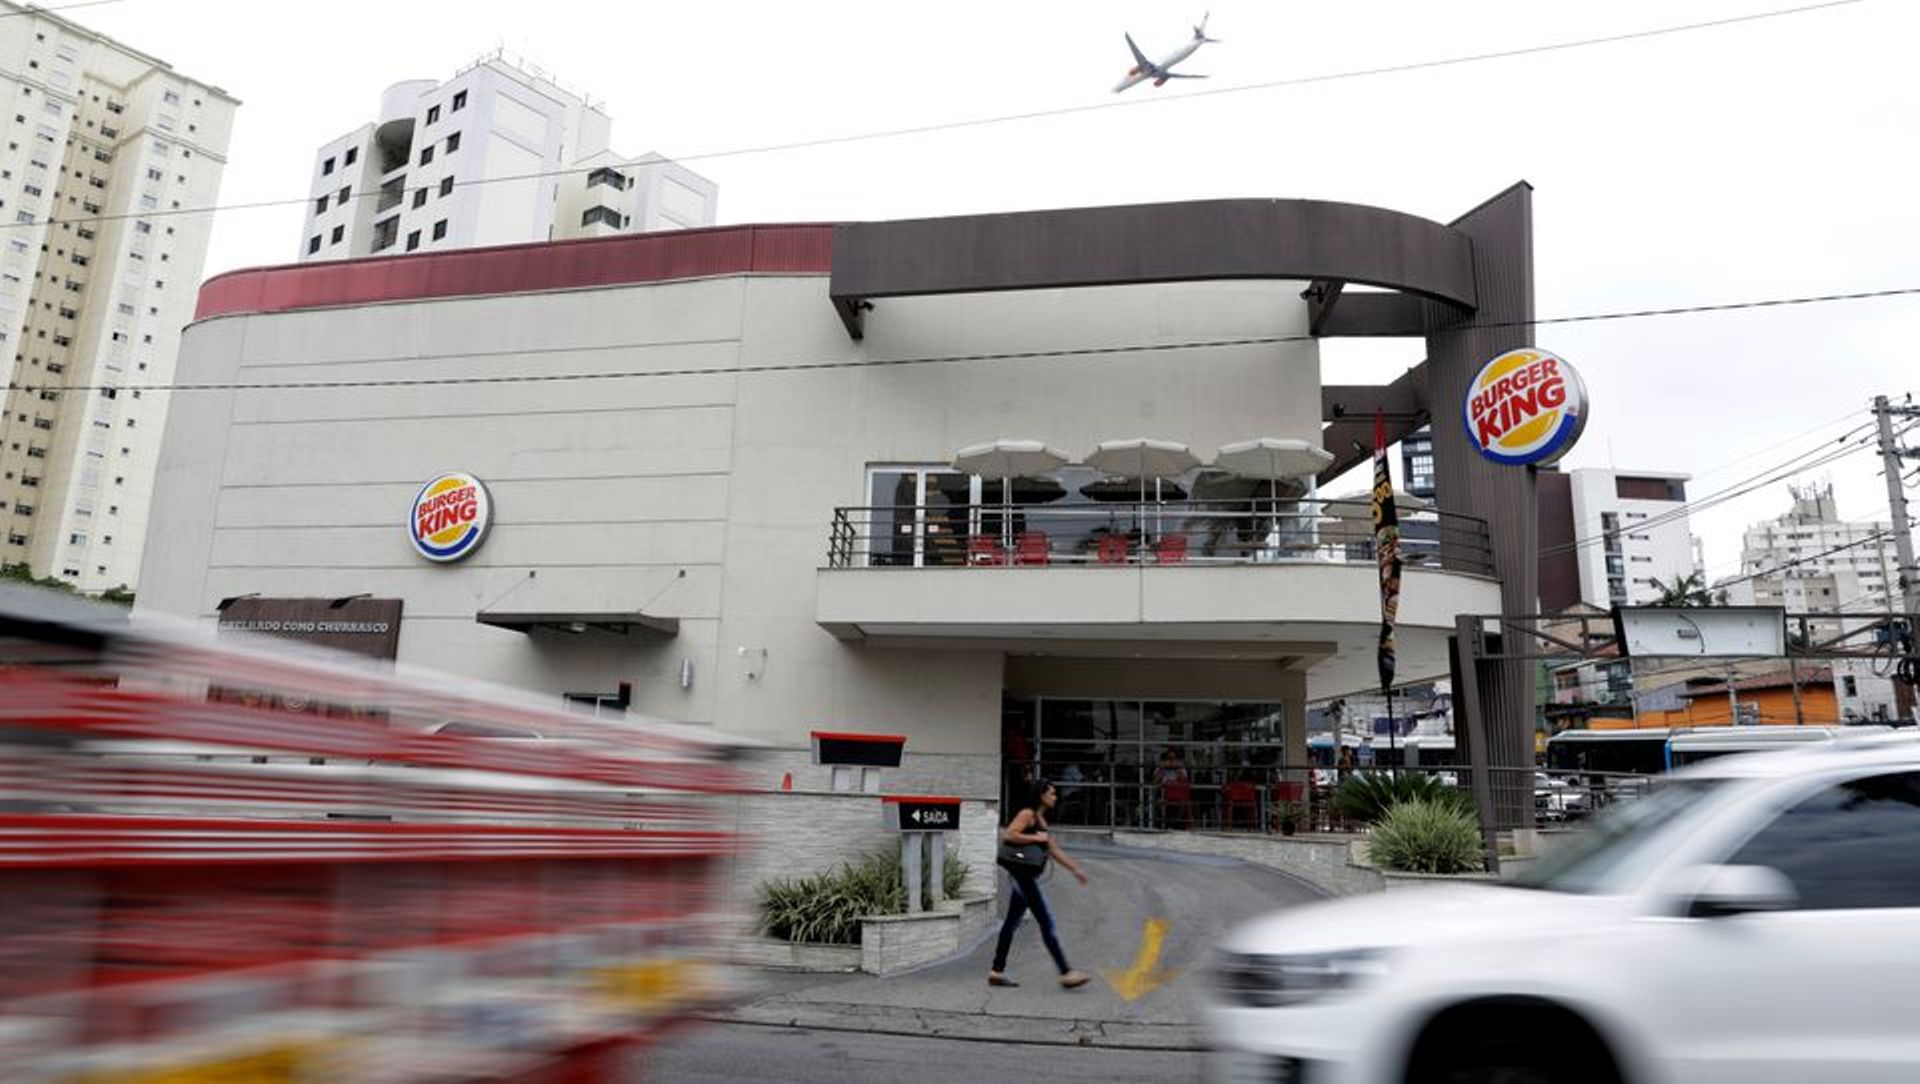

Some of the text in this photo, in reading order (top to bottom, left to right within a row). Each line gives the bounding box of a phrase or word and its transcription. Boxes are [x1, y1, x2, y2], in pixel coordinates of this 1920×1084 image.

[1471, 358, 1558, 420] BURGER
[1477, 377, 1566, 448] KING
[418, 486, 476, 518] BURGER
[418, 500, 477, 539] KING
[282, 621, 314, 633] COMO
